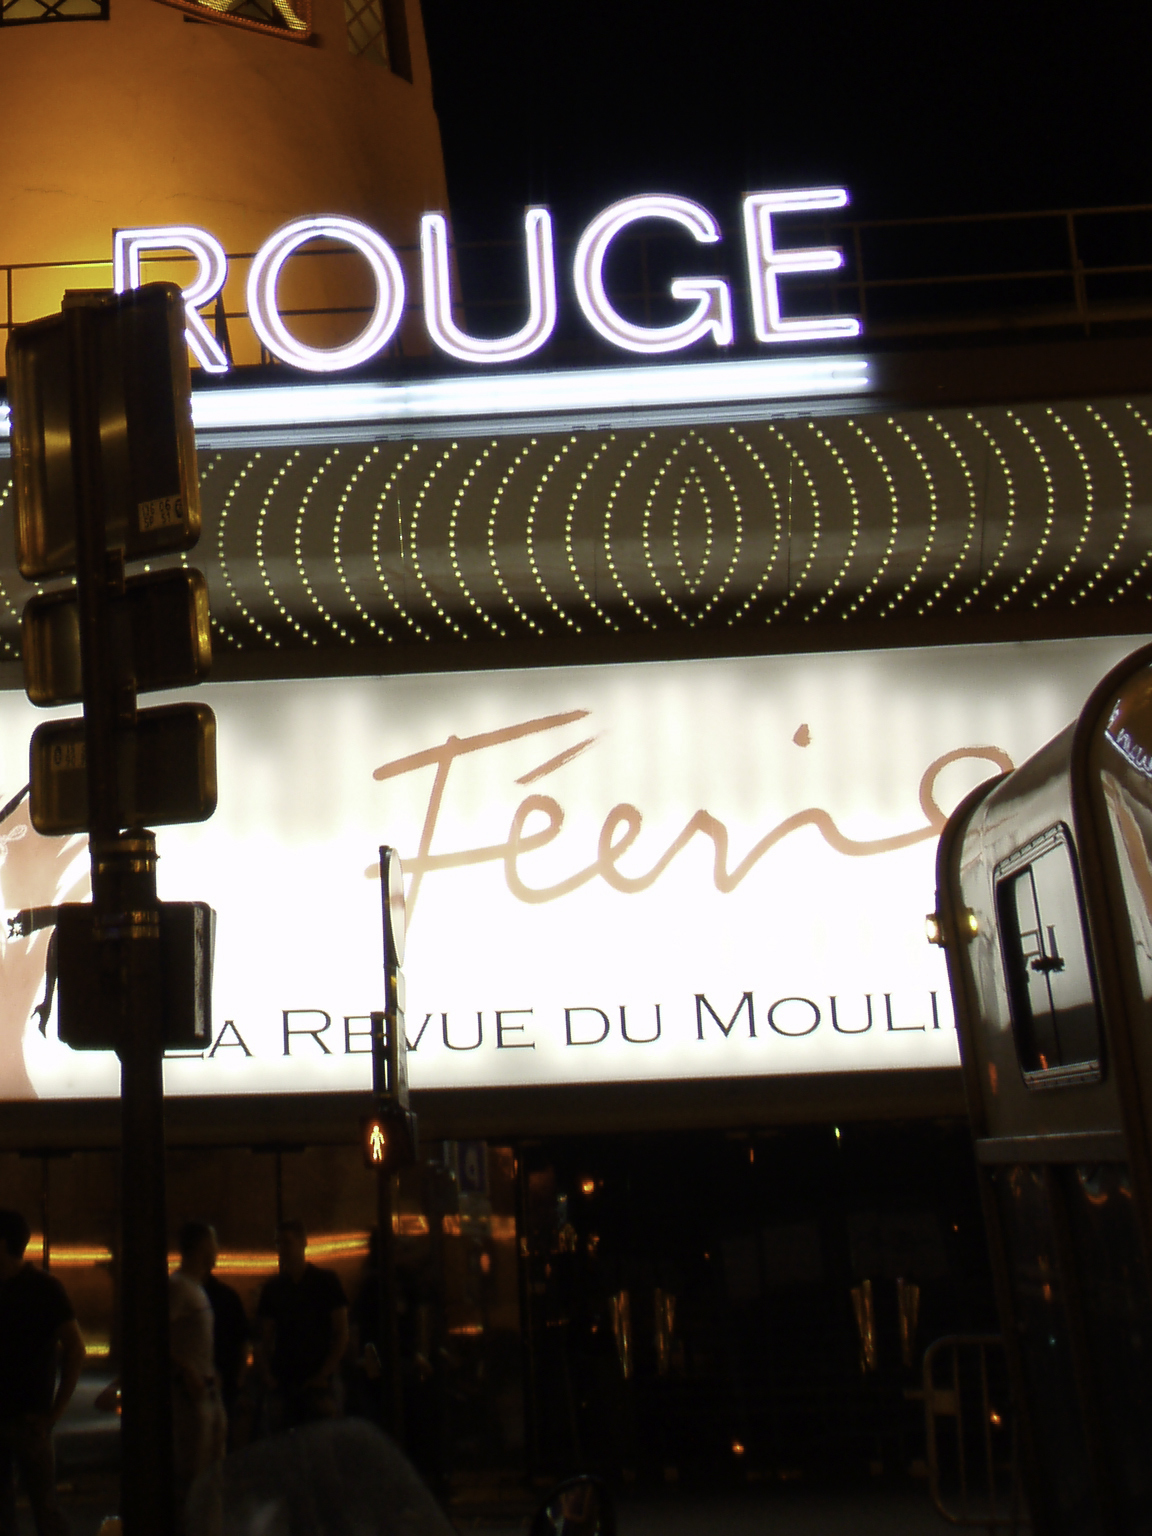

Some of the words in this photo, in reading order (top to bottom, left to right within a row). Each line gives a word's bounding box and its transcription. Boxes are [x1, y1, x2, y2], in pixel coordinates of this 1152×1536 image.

[112, 185, 861, 375] ROUGE
[564, 1003, 662, 1046] DU
[694, 990, 959, 1040] MOULI
